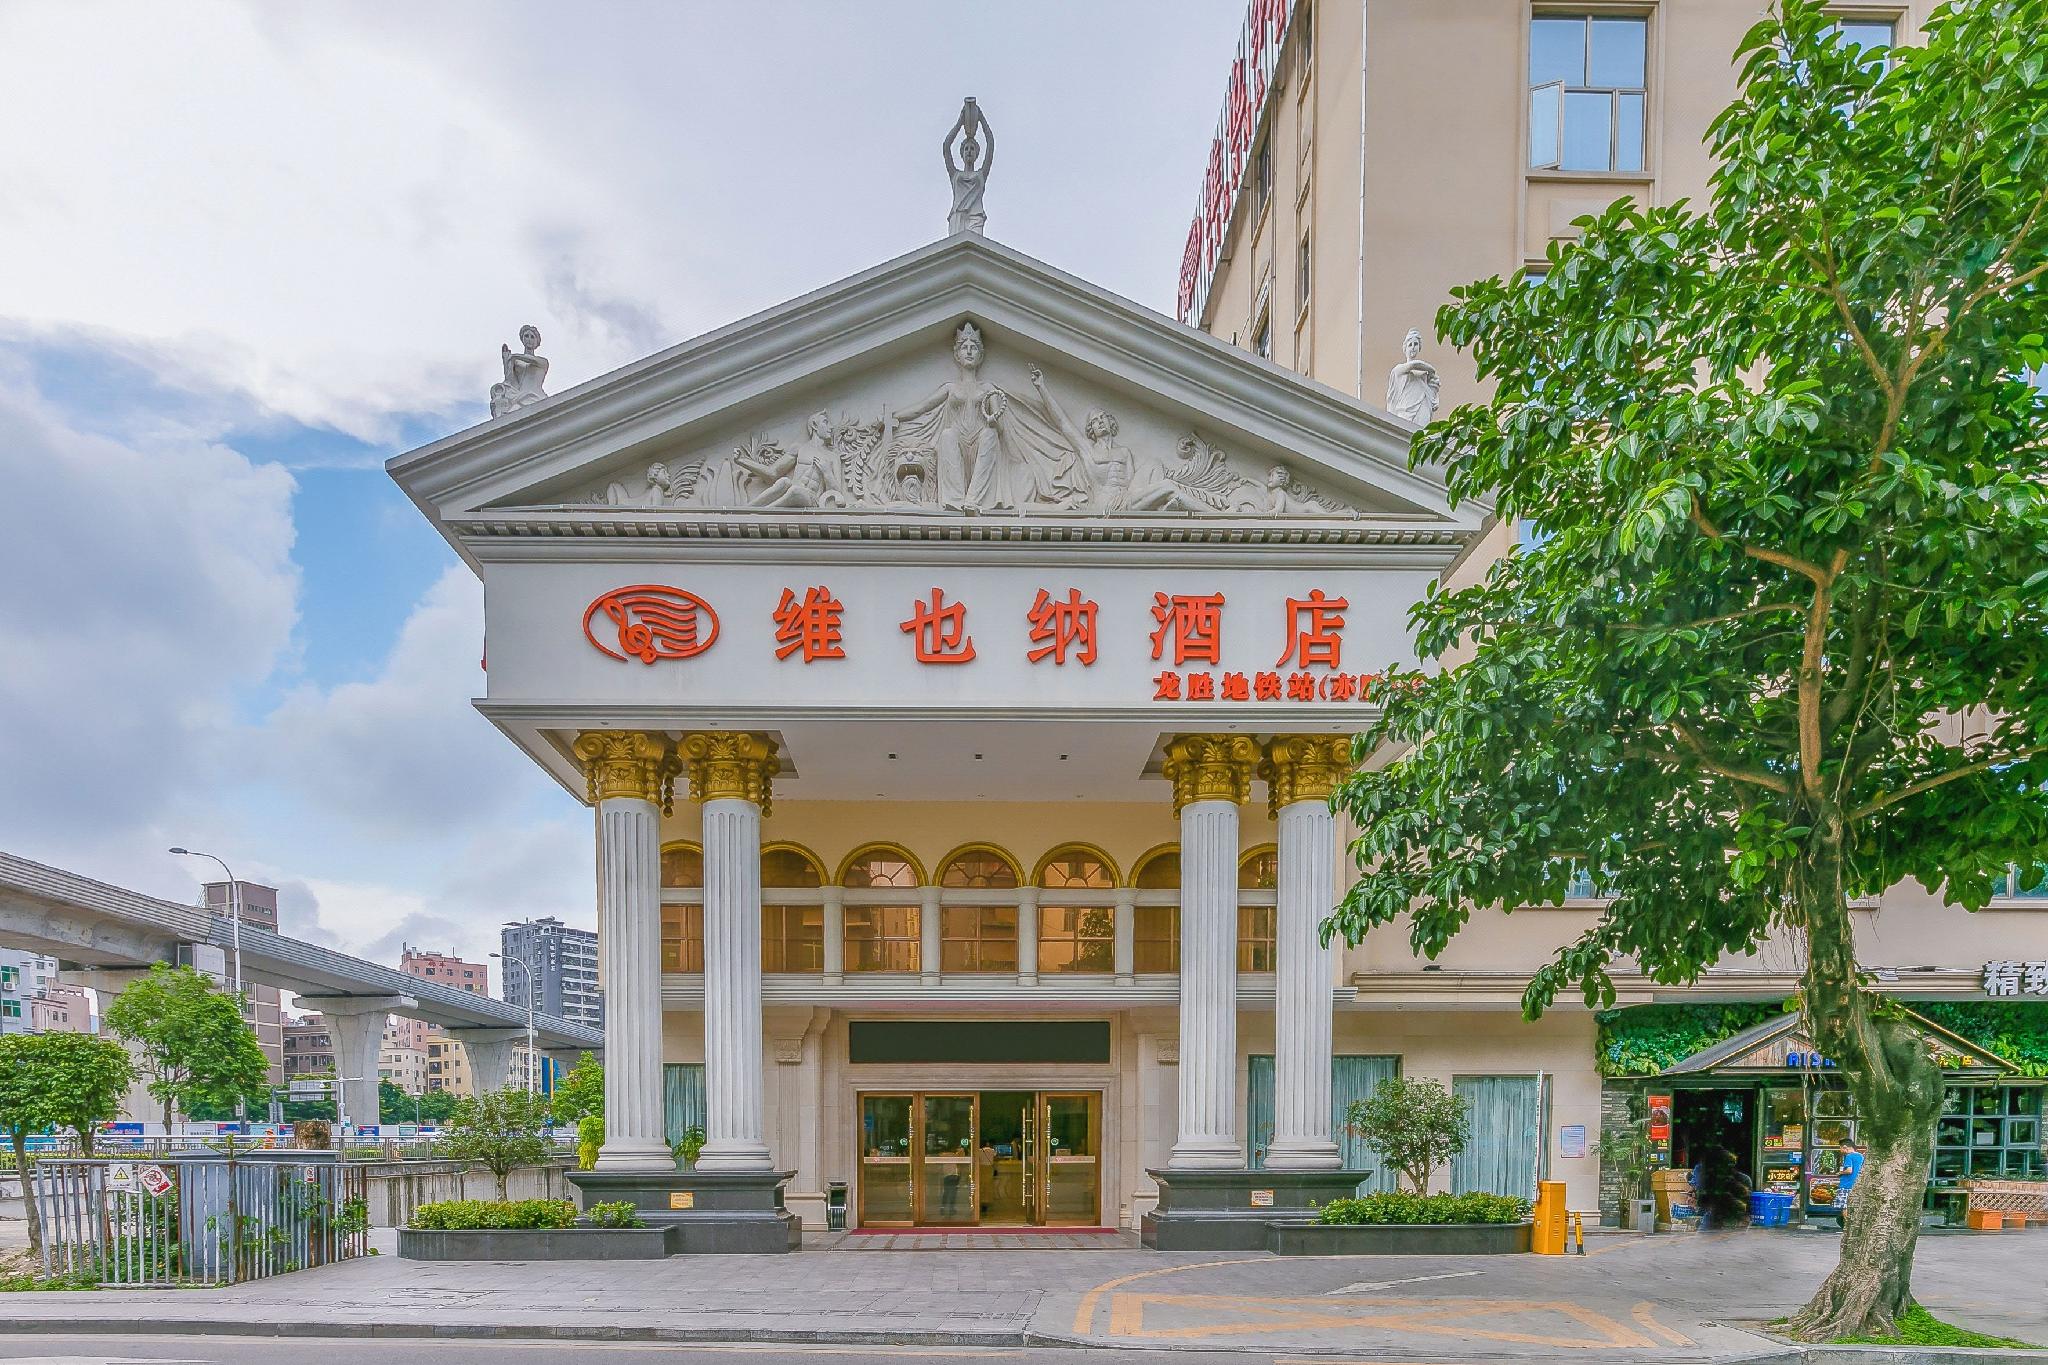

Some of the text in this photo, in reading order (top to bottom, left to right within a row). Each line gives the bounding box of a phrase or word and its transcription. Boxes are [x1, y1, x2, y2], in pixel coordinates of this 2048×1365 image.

[773, 587, 1350, 669] 维也纳酒店
